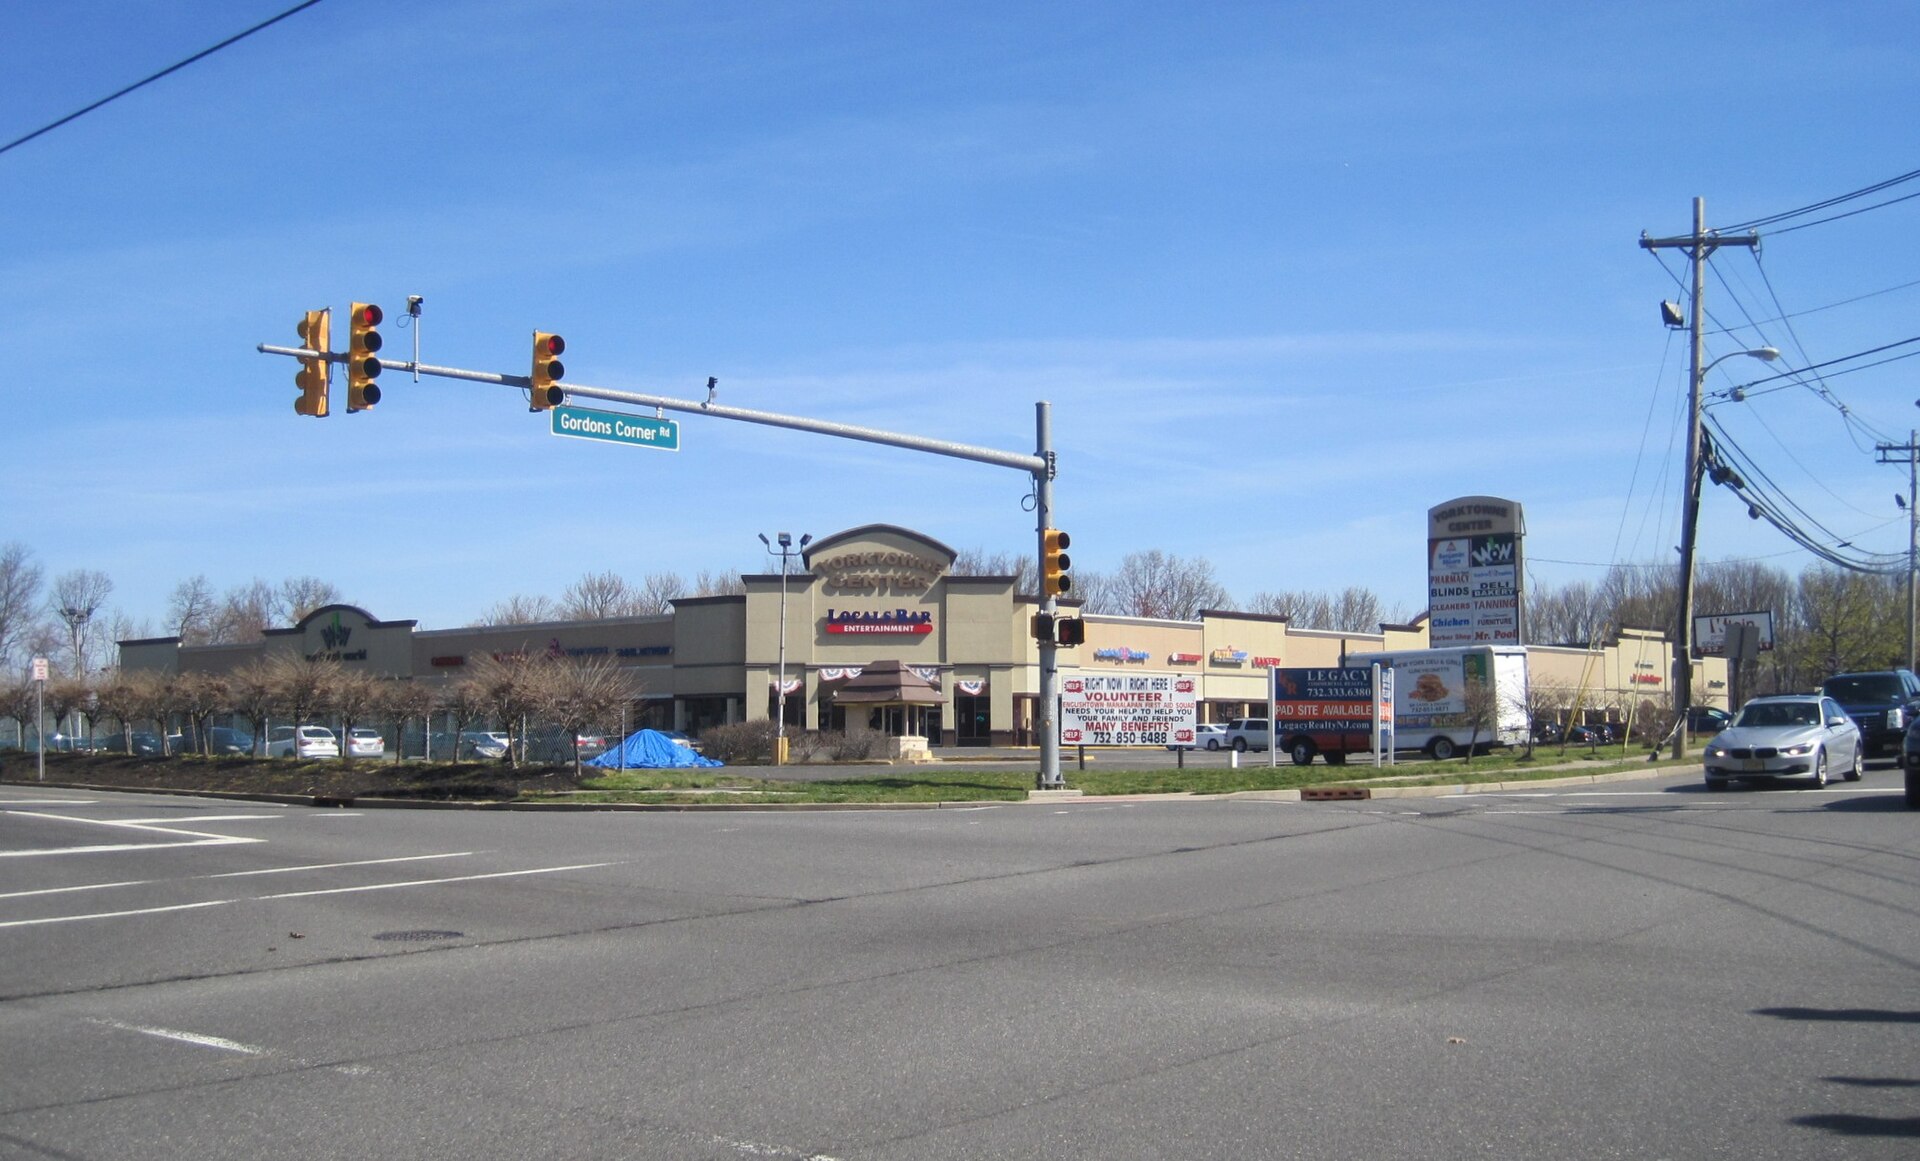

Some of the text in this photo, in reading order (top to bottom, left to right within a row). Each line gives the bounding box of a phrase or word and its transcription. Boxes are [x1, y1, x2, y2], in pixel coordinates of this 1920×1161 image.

[561, 413, 670, 441] Gordons Corner Rd
[1448, 519, 1493, 532] CENTER
[817, 552, 943, 575] YORKTOWNE
[830, 575, 931, 588] CENTER
[1431, 574, 1469, 585] PHARMACY
[1480, 581, 1510, 589] DELI
[1431, 587, 1469, 597] BLINDS
[1431, 602, 1470, 611] CLEANERS
[1474, 599, 1516, 610] TANNING
[896, 609, 932, 624] BAR
[1432, 617, 1469, 627] Chicken
[1494, 629, 1517, 639] Pool
[1307, 671, 1369, 681] LEGACY
[1085, 678, 1104, 690] RIGHT
[1106, 678, 1122, 690] NOW
[1129, 678, 1148, 690] RIGHT
[1151, 678, 1168, 690] HERE
[1085, 693, 1162, 701] VOLUNTEER
[1307, 688, 1371, 697] 732.333.6380
[1275, 705, 1293, 715] PAD
[1298, 705, 1318, 715] SITE
[1323, 705, 1371, 715] AVAILABLE
[1086, 722, 1116, 731] MANY
[1279, 721, 1369, 731] LegacyRealtyNJ.com
